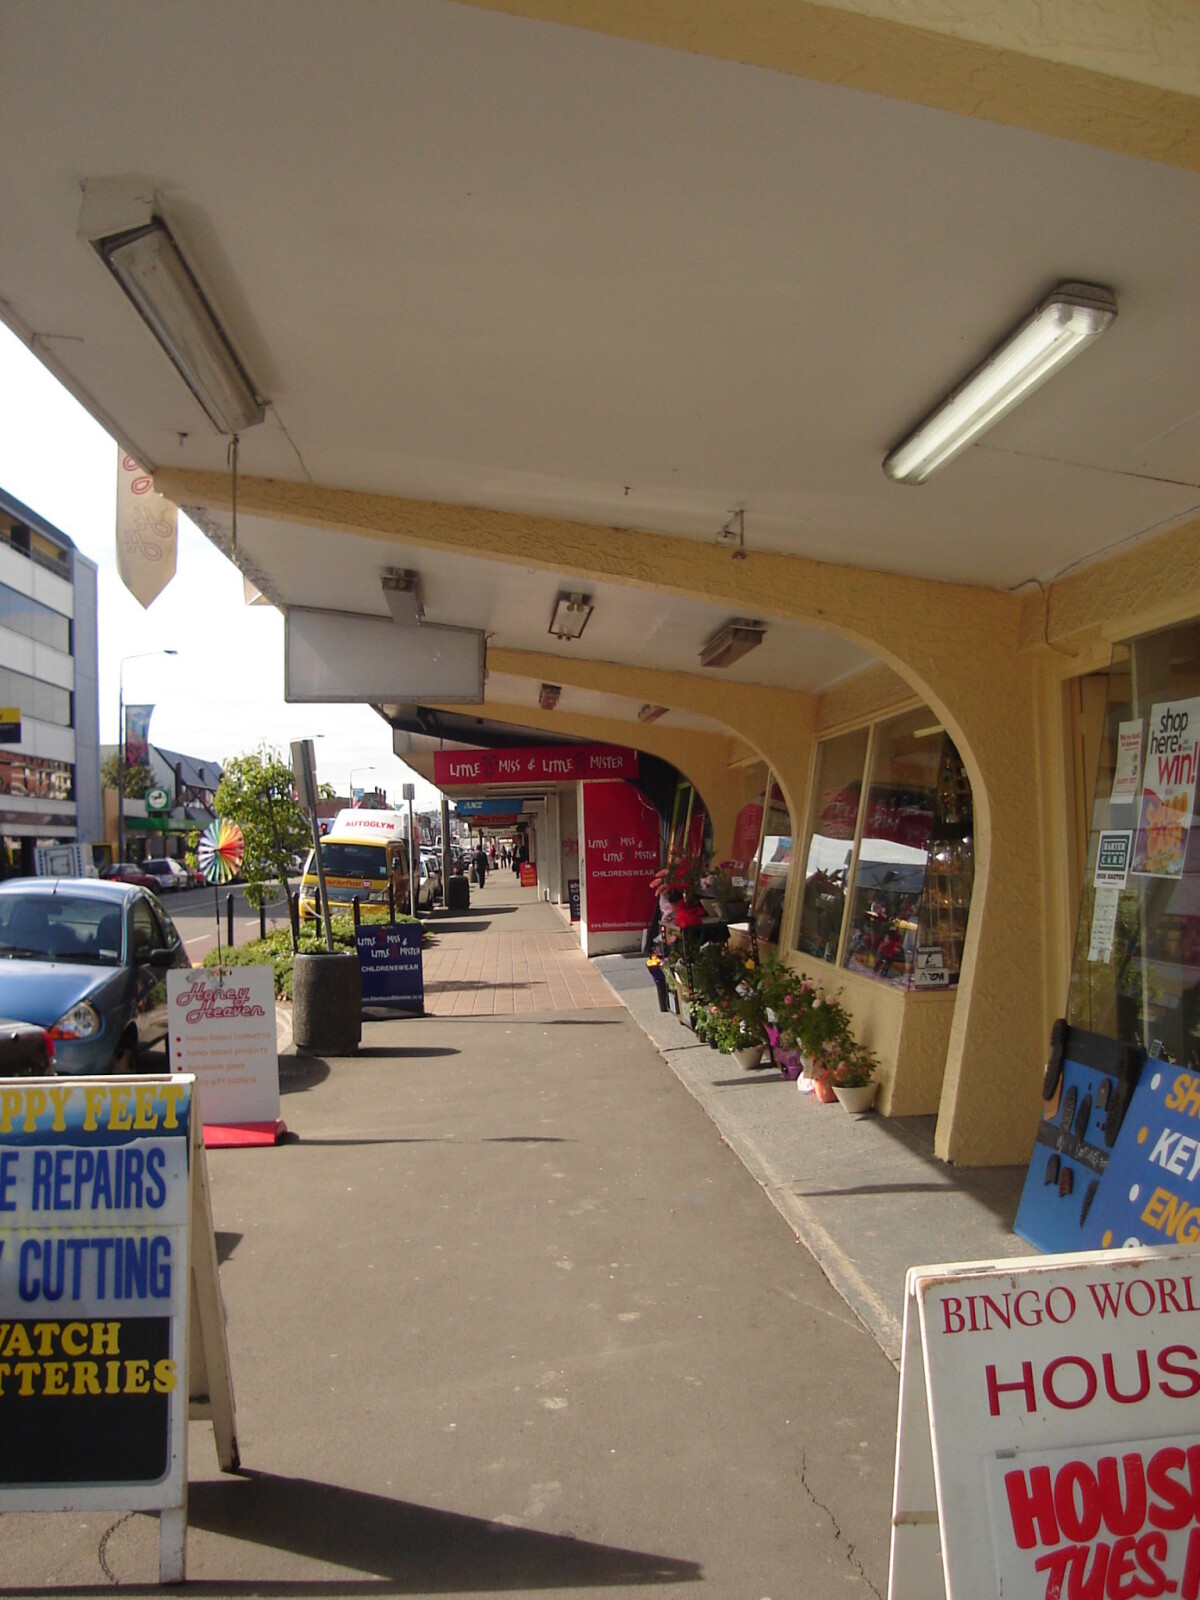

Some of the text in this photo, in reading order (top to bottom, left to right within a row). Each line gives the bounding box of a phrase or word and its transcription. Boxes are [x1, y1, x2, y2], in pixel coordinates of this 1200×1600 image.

[1160, 707, 1188, 738] shop
[1150, 730, 1178, 755] here
[450, 763, 480, 778] LITTLE
[498, 759, 521, 773] MISS
[542, 758, 573, 773] LITTLE
[590, 756, 623, 770] MISTER
[1158, 741, 1198, 786] win!
[463, 801, 483, 810] ANZ
[345, 820, 395, 830] AUTOGLYM
[588, 839, 608, 849] LITTLE
[620, 837, 635, 846] MISS
[1103, 842, 1126, 851] BARTER
[603, 852, 624, 862] LITTLE
[1101, 855, 1124, 864] CARD
[592, 869, 655, 878] CHILDRENSWEAR
[325, 879, 362, 888] ourierPost
[357, 936, 376, 947] LITTLE
[386, 934, 401, 944] MISS
[371, 946, 421, 958] LITTLE MISTER
[361, 964, 419, 973] CHILDRENSWEAR
[176, 981, 250, 1007] Honey
[186, 999, 265, 1024] Heaven
[83, 1084, 185, 1132] FEET
[32, 1147, 166, 1211] REPAIRS
[19, 1235, 172, 1303] CUTTING
[940, 1285, 1077, 1335] BINGO
[0, 1321, 122, 1358] ATCH
